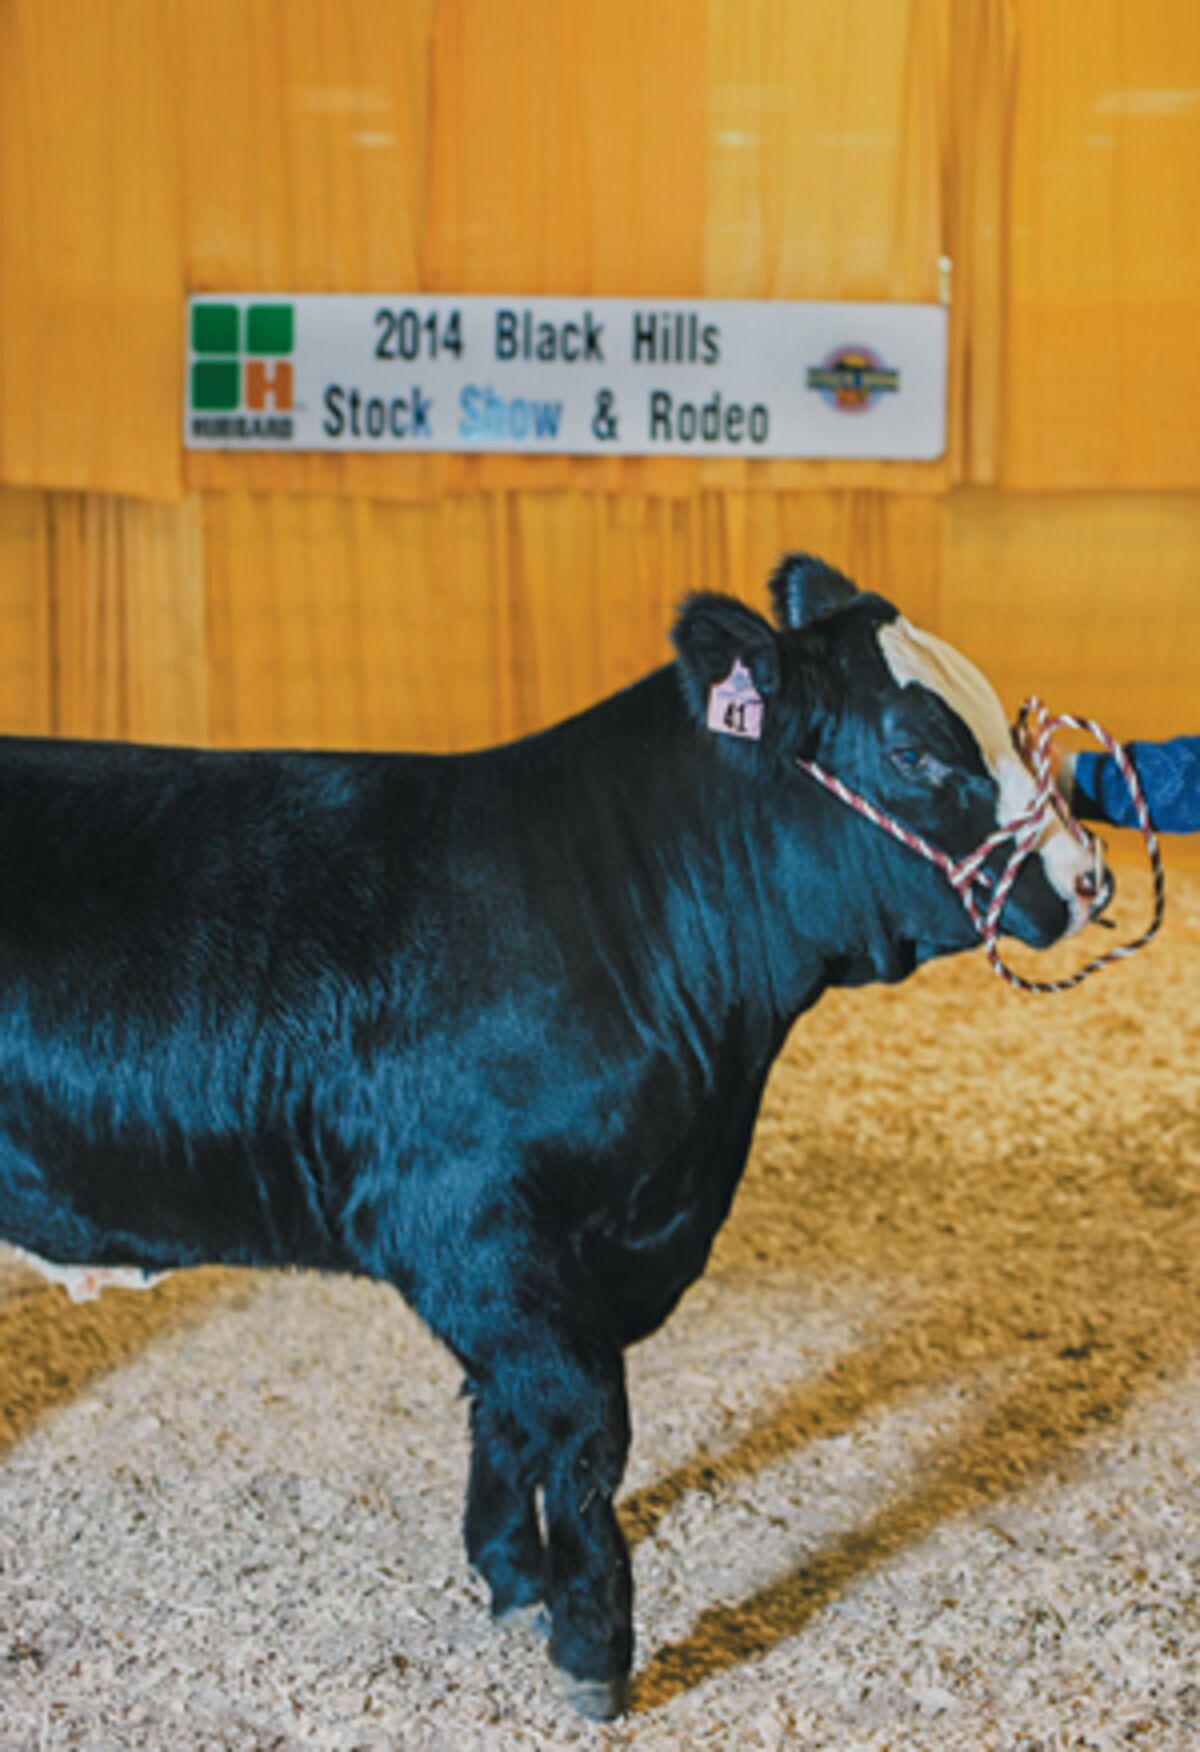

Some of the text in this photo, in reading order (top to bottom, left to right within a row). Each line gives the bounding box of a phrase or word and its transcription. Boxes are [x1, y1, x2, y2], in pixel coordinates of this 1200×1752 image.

[374, 307, 720, 364] 2014 Black Hills
[323, 383, 769, 443] Stock Show & Rodeo
